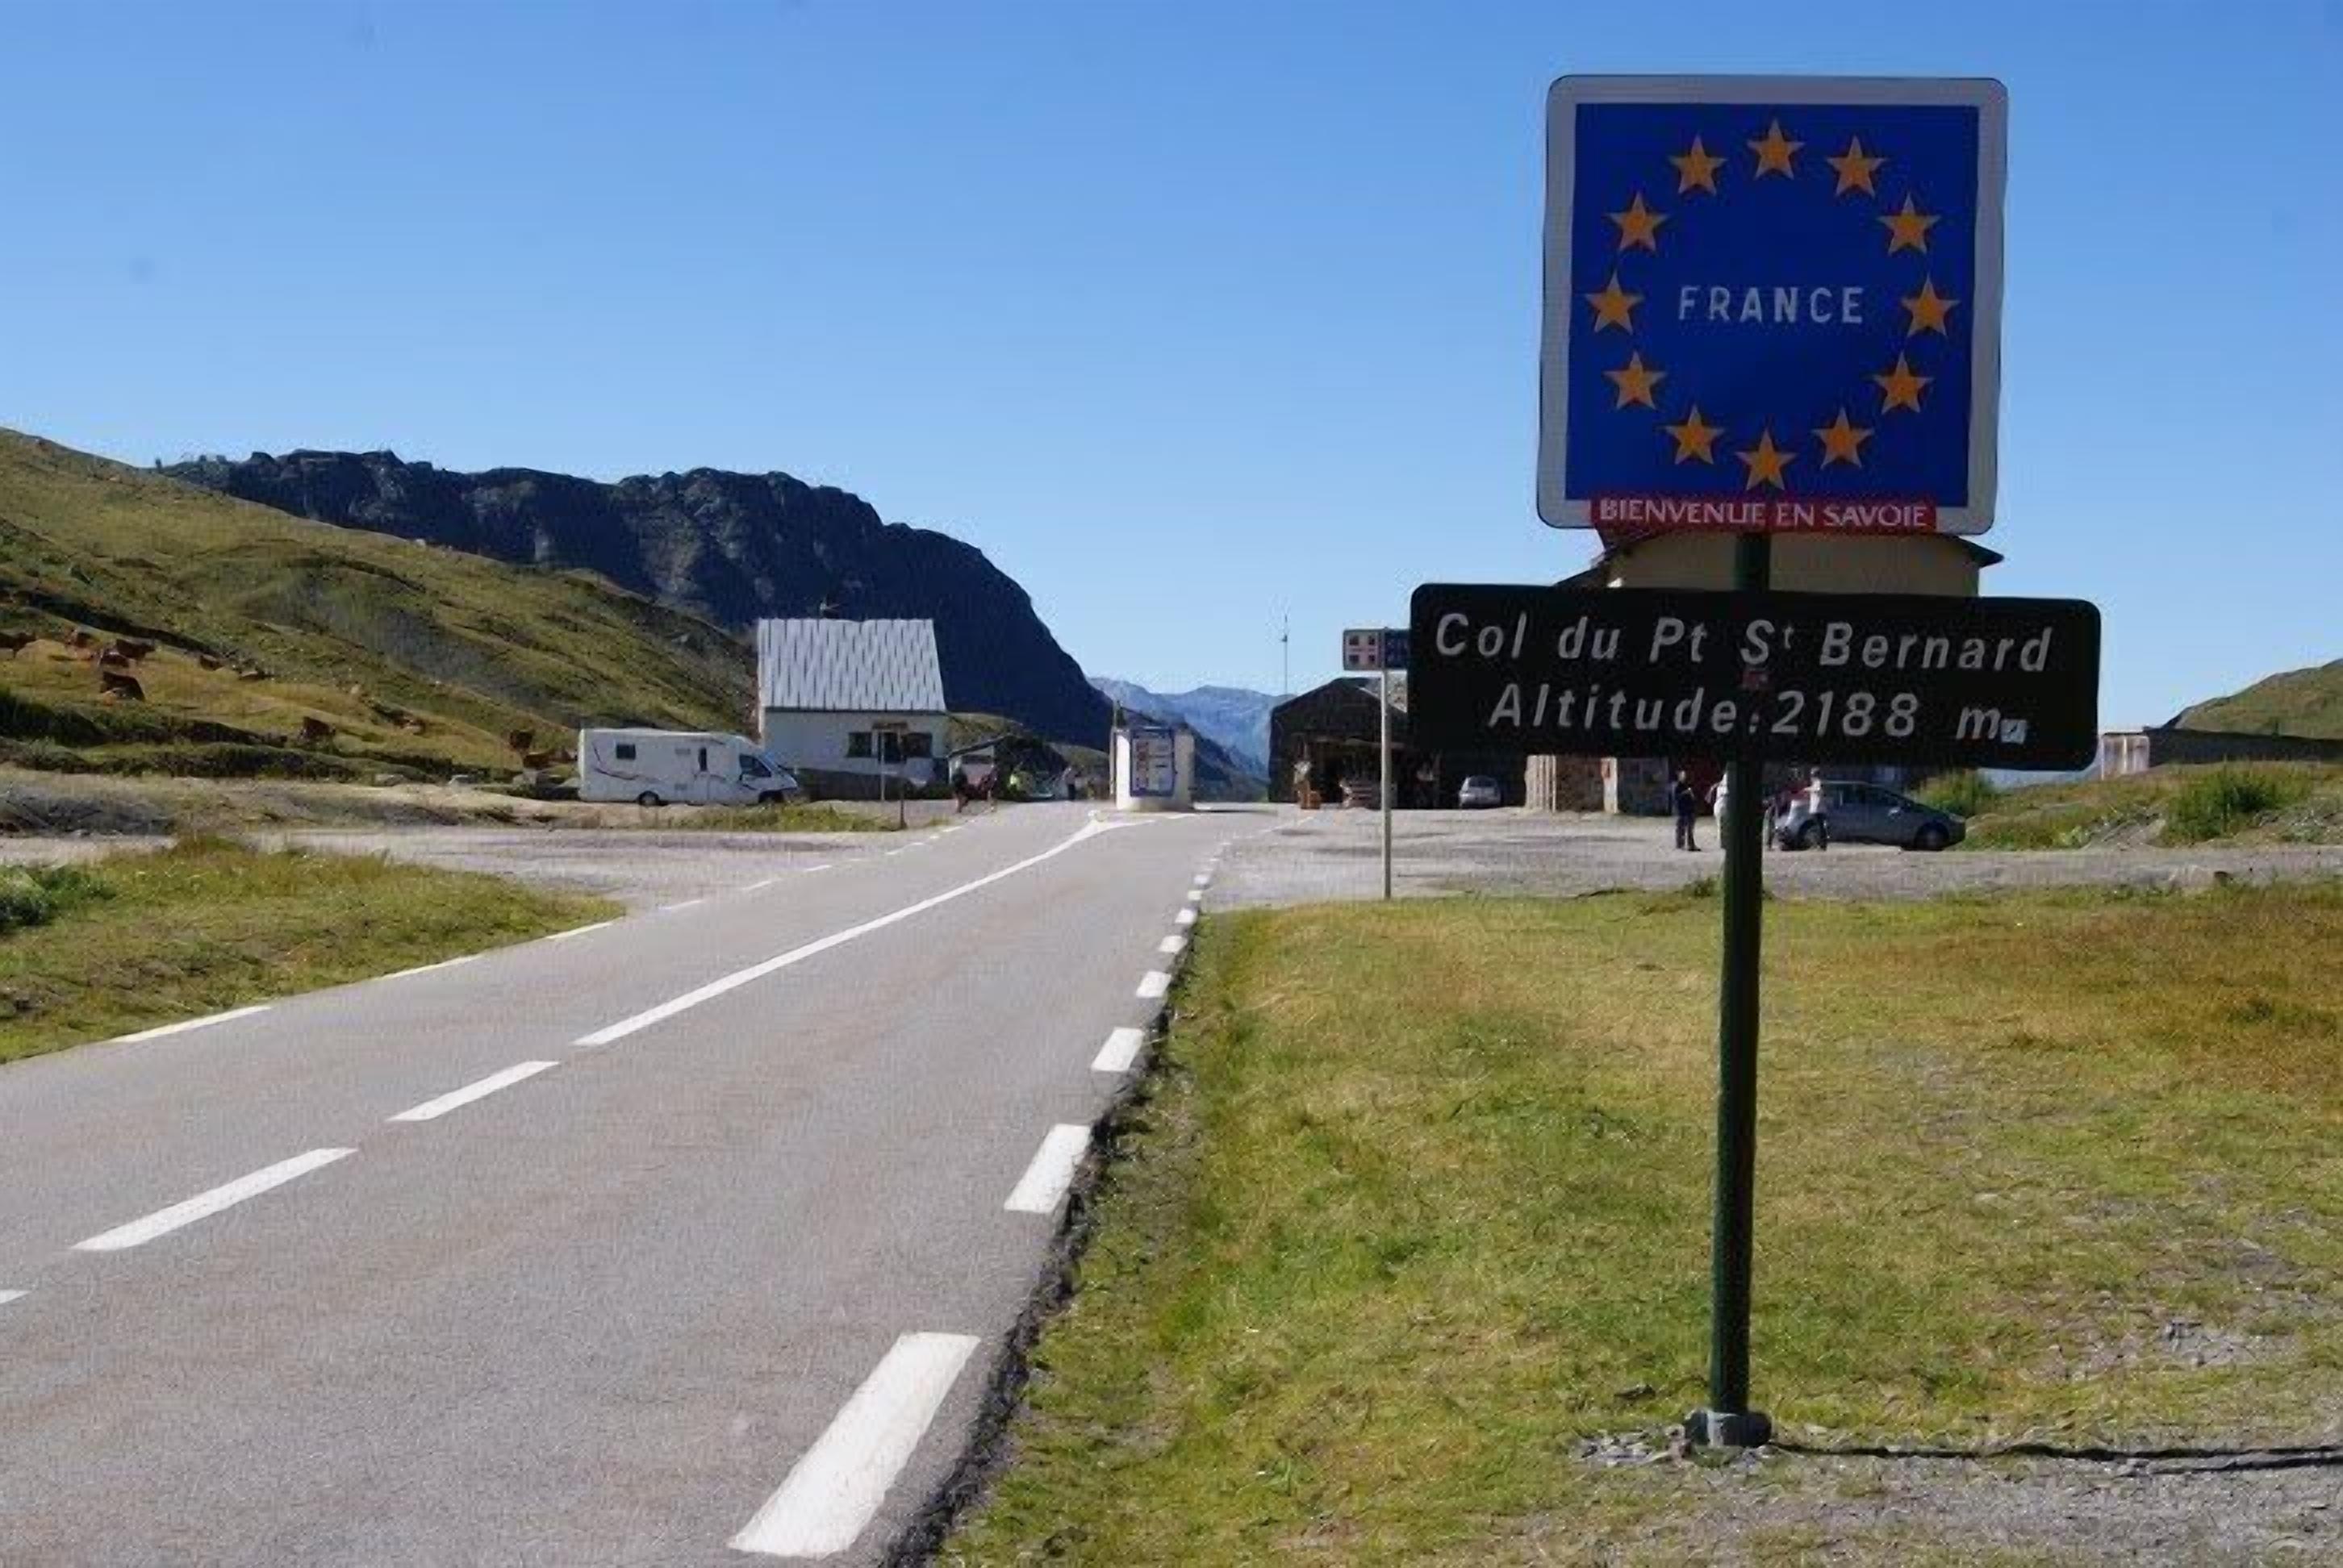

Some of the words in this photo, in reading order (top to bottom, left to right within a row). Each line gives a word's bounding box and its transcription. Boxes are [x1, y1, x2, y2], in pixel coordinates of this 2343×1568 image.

[1678, 286, 1864, 324] FRANCE
[1599, 498, 1767, 525] BIENVENUE
[1777, 505, 1815, 527] EN
[1823, 506, 1928, 528] SAVOIE
[1435, 611, 1528, 658] Col
[1557, 615, 1622, 660] du
[1648, 618, 1708, 662] Pt
[1740, 619, 1794, 665] St
[1819, 622, 2053, 671] Bernard
[1955, 707, 2002, 740] m
